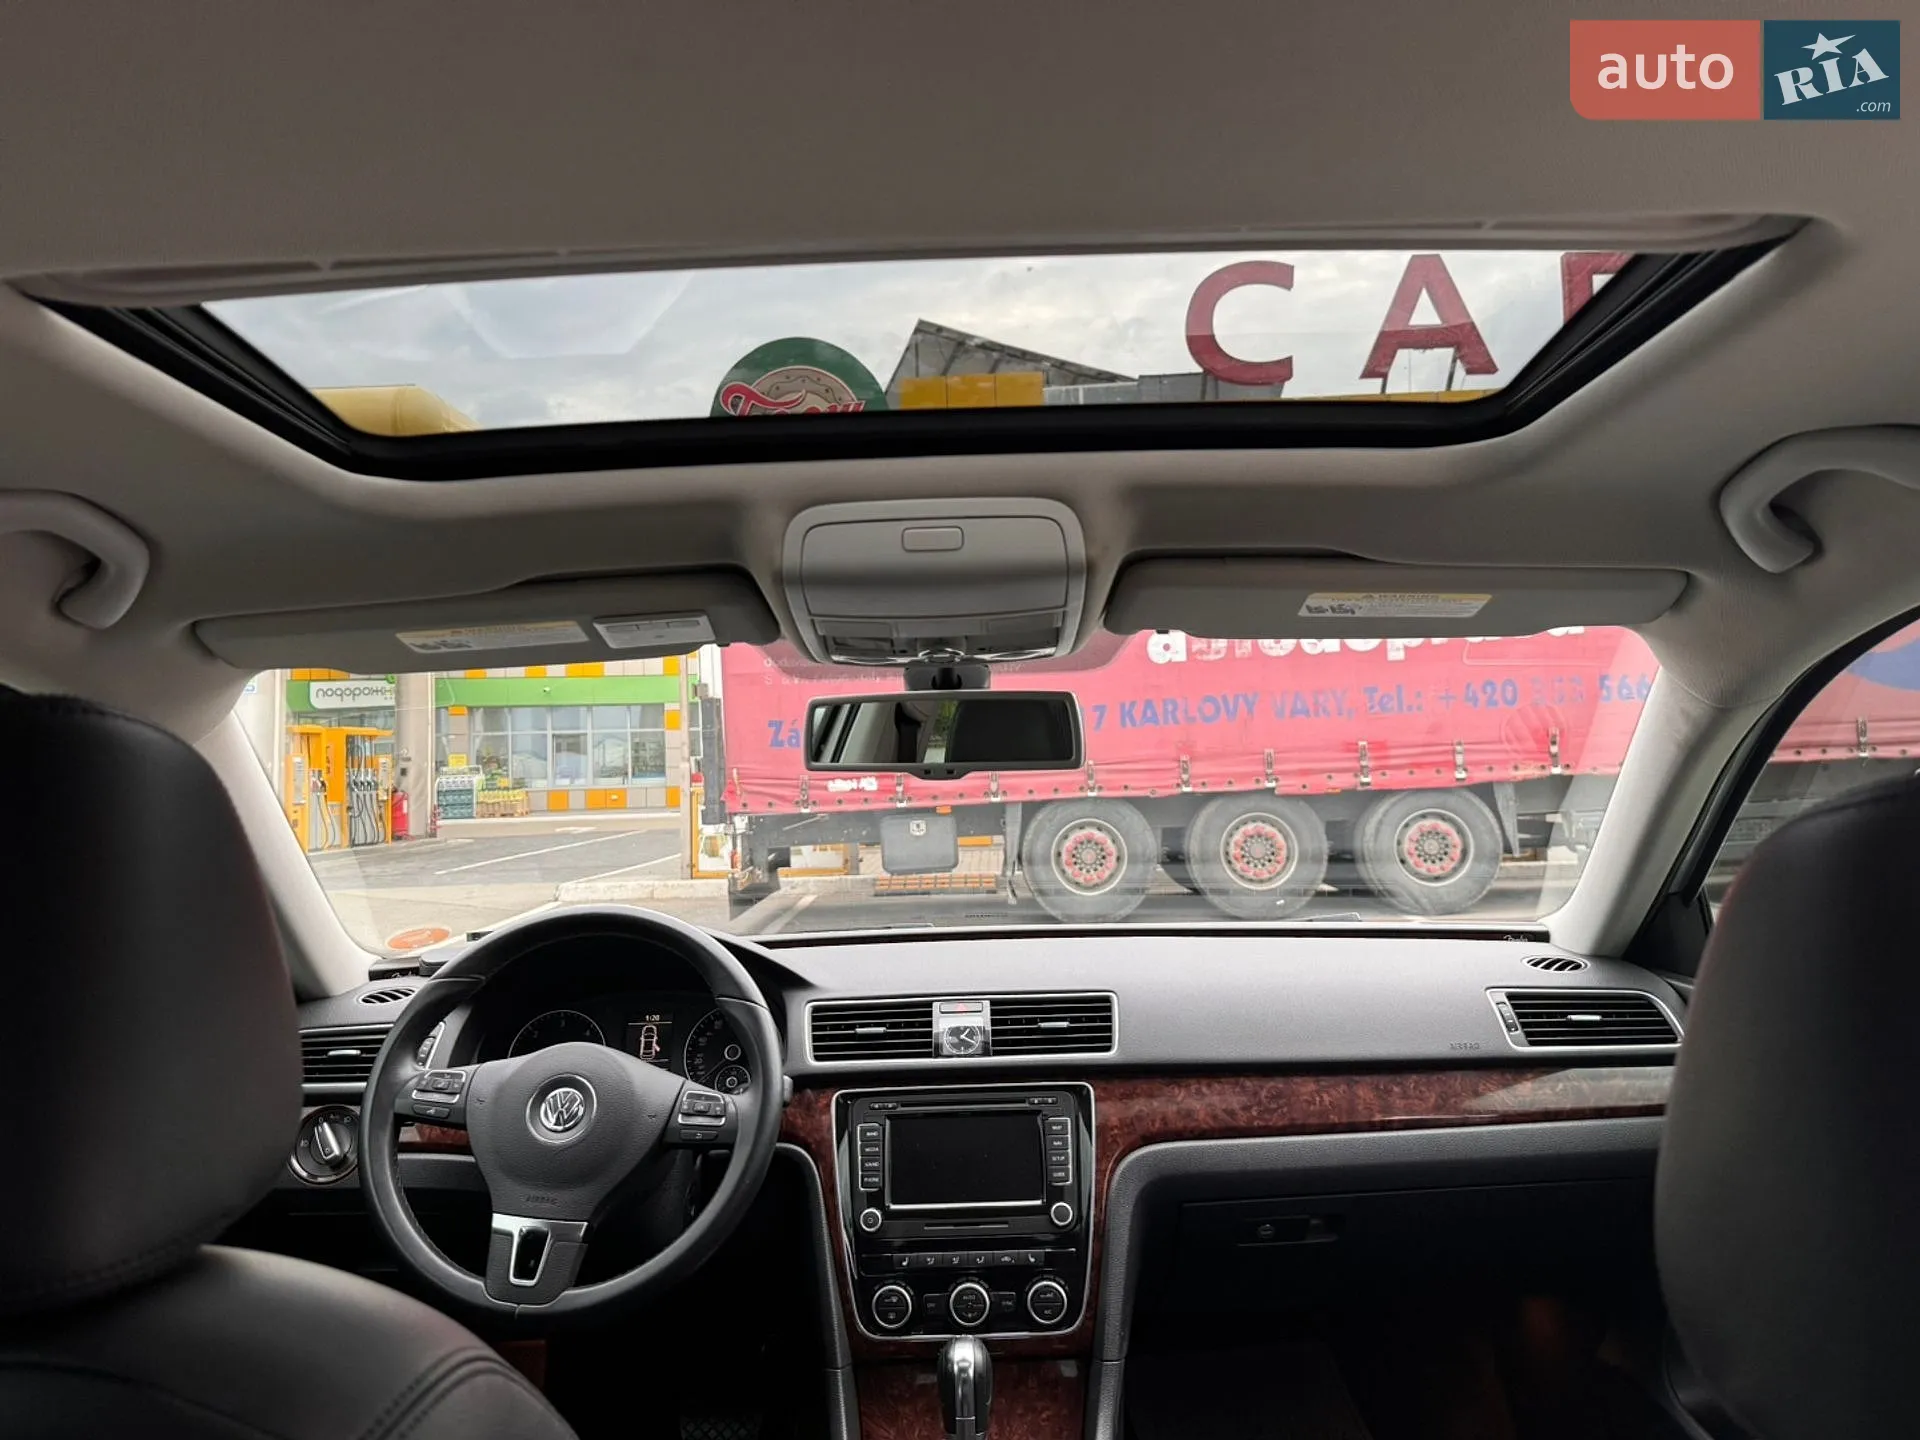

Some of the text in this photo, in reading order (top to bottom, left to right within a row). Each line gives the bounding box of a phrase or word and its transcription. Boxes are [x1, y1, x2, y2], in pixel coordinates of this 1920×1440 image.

[315, 685, 394, 703] подорожн
[1118, 691, 1260, 729] KARLOVY
[1271, 686, 1355, 721] VARY,
[1362, 684, 1424, 716] Tel.:
